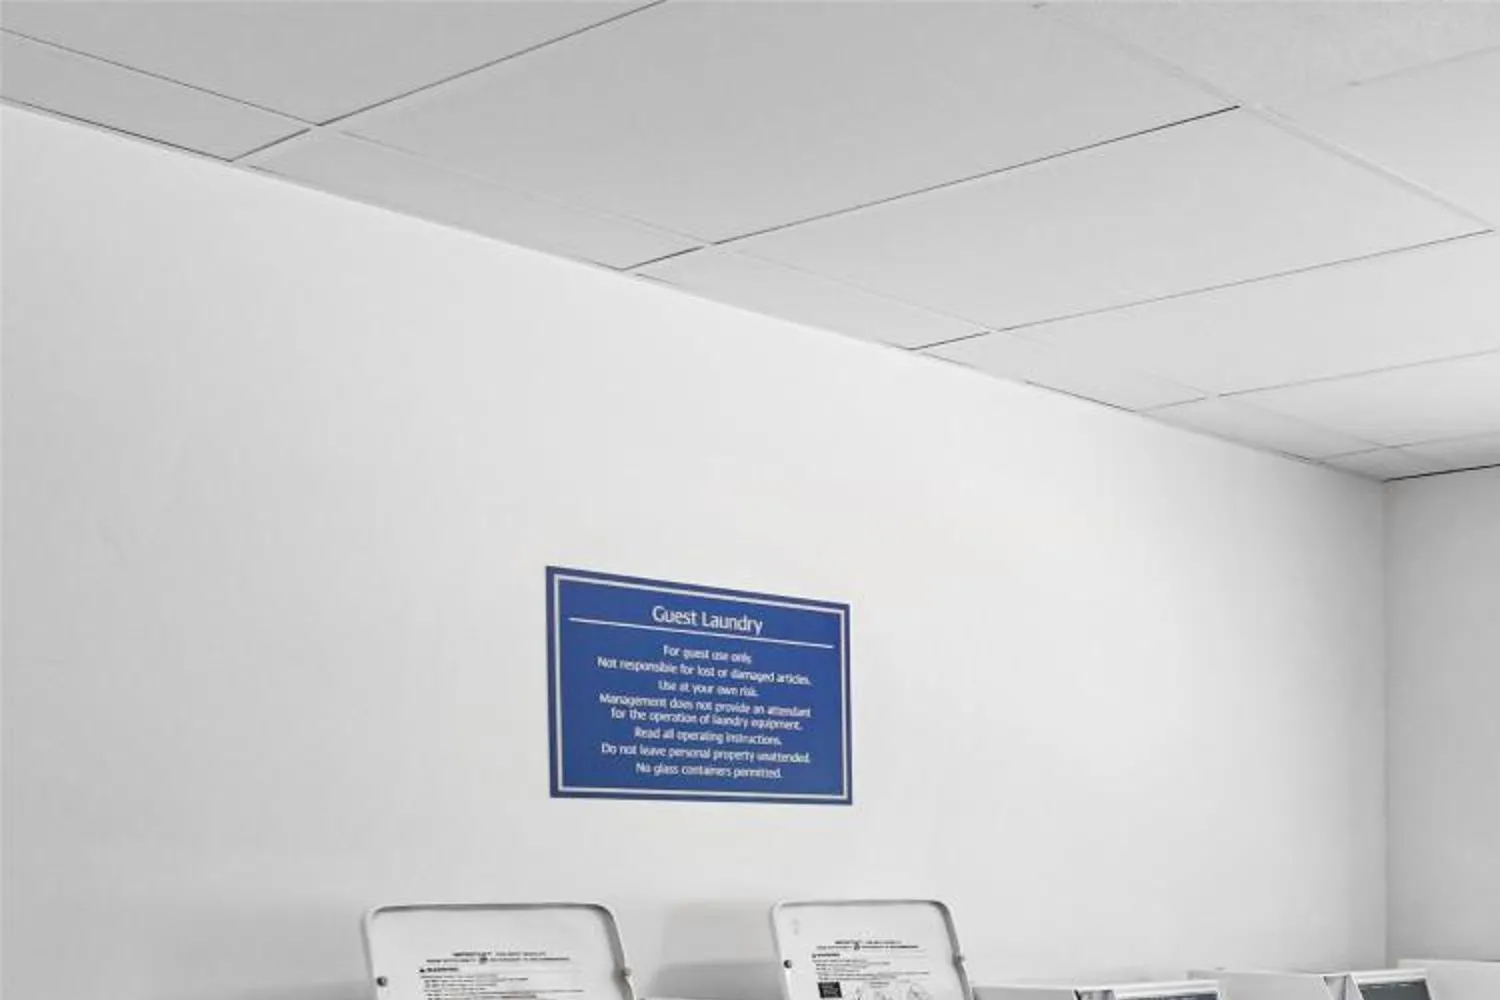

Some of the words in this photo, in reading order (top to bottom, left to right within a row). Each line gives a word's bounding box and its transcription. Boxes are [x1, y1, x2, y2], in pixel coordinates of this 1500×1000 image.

[652, 605, 698, 627] Guest
[701, 611, 763, 636] Laundry
[663, 644, 680, 656] For
[683, 649, 709, 659] guest
[711, 652, 729, 660] use
[597, 655, 617, 668] Not
[619, 660, 678, 673] responsible
[680, 663, 694, 674] for
[697, 664, 715, 676] lost
[717, 668, 728, 676] or
[730, 668, 775, 682] damaged
[776, 672, 813, 685] articles.
[657, 680, 676, 691] Use
[679, 682, 690, 692] at
[692, 685, 714, 695] your
[716, 685, 738, 694] own
[599, 692, 667, 708] Management
[669, 697, 693, 709] does
[695, 700, 712, 710] not
[714, 700, 751, 714] provide
[753, 705, 765, 714] an
[767, 705, 811, 717] attendant
[611, 706, 626, 718] for
[628, 708, 646, 720] the
[648, 713, 697, 724] operation
[699, 714, 710, 723] of
[711, 716, 748, 729] laundry
[634, 726, 660, 738] Read
[662, 728, 674, 738] all
[676, 731, 723, 744] operating
[601, 742, 617, 754] Do
[619, 744, 637, 754] not
[639, 744, 666, 756] leave
[668, 747, 711, 758] personal
[713, 749, 754, 762] property
[636, 762, 651, 773] No
[653, 763, 679, 776] glass
[681, 765, 733, 776] containers
